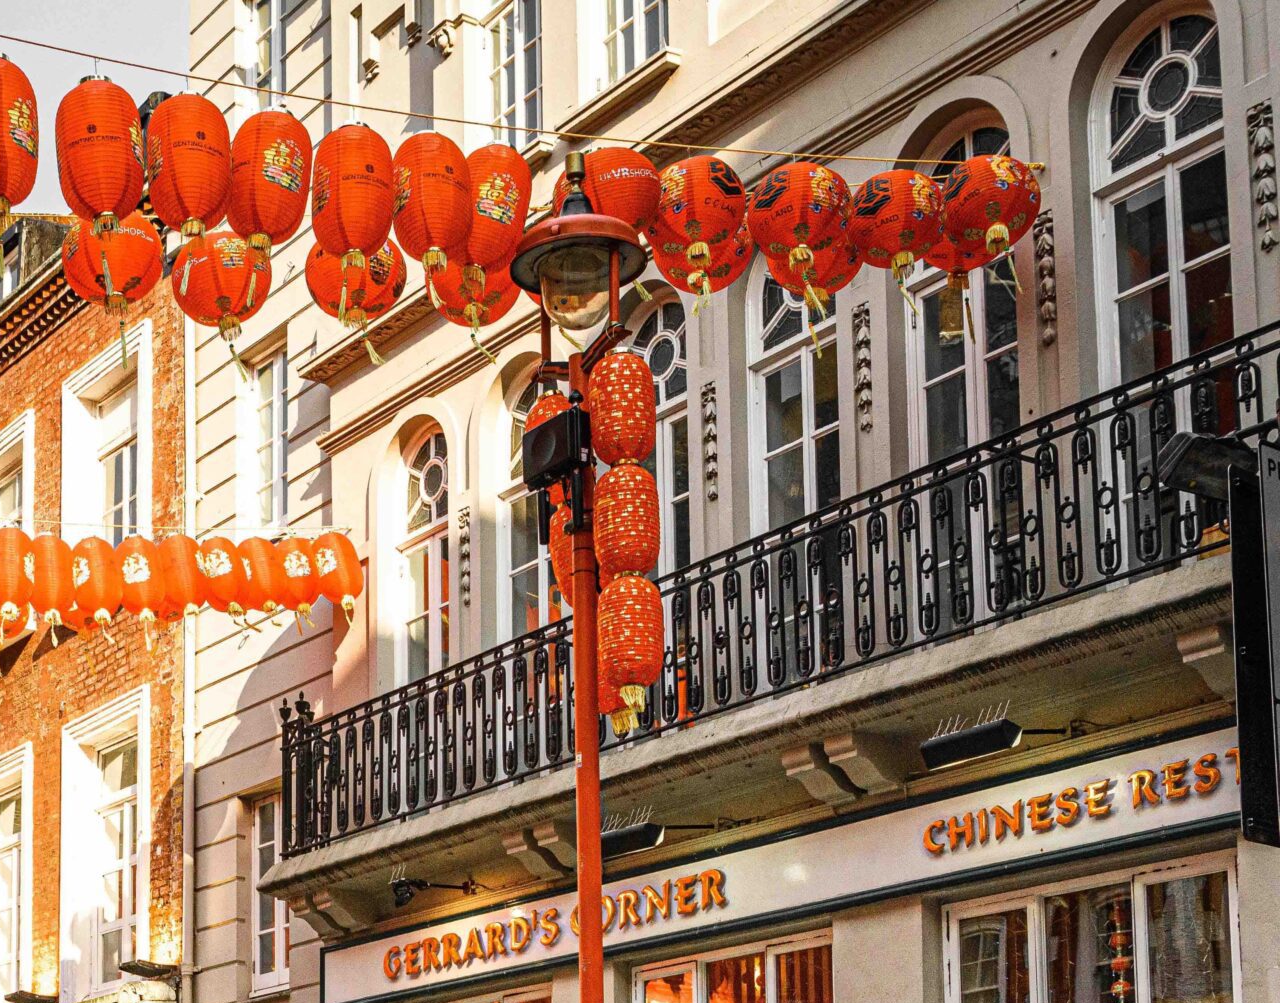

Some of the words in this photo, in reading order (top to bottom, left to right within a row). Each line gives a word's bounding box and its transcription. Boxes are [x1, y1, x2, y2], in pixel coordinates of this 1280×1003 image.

[770, 204, 794, 220] LAND
[874, 214, 900, 228] LAND
[922, 777, 1114, 854] CHINESE
[383, 908, 558, 979] GERRARD'S
